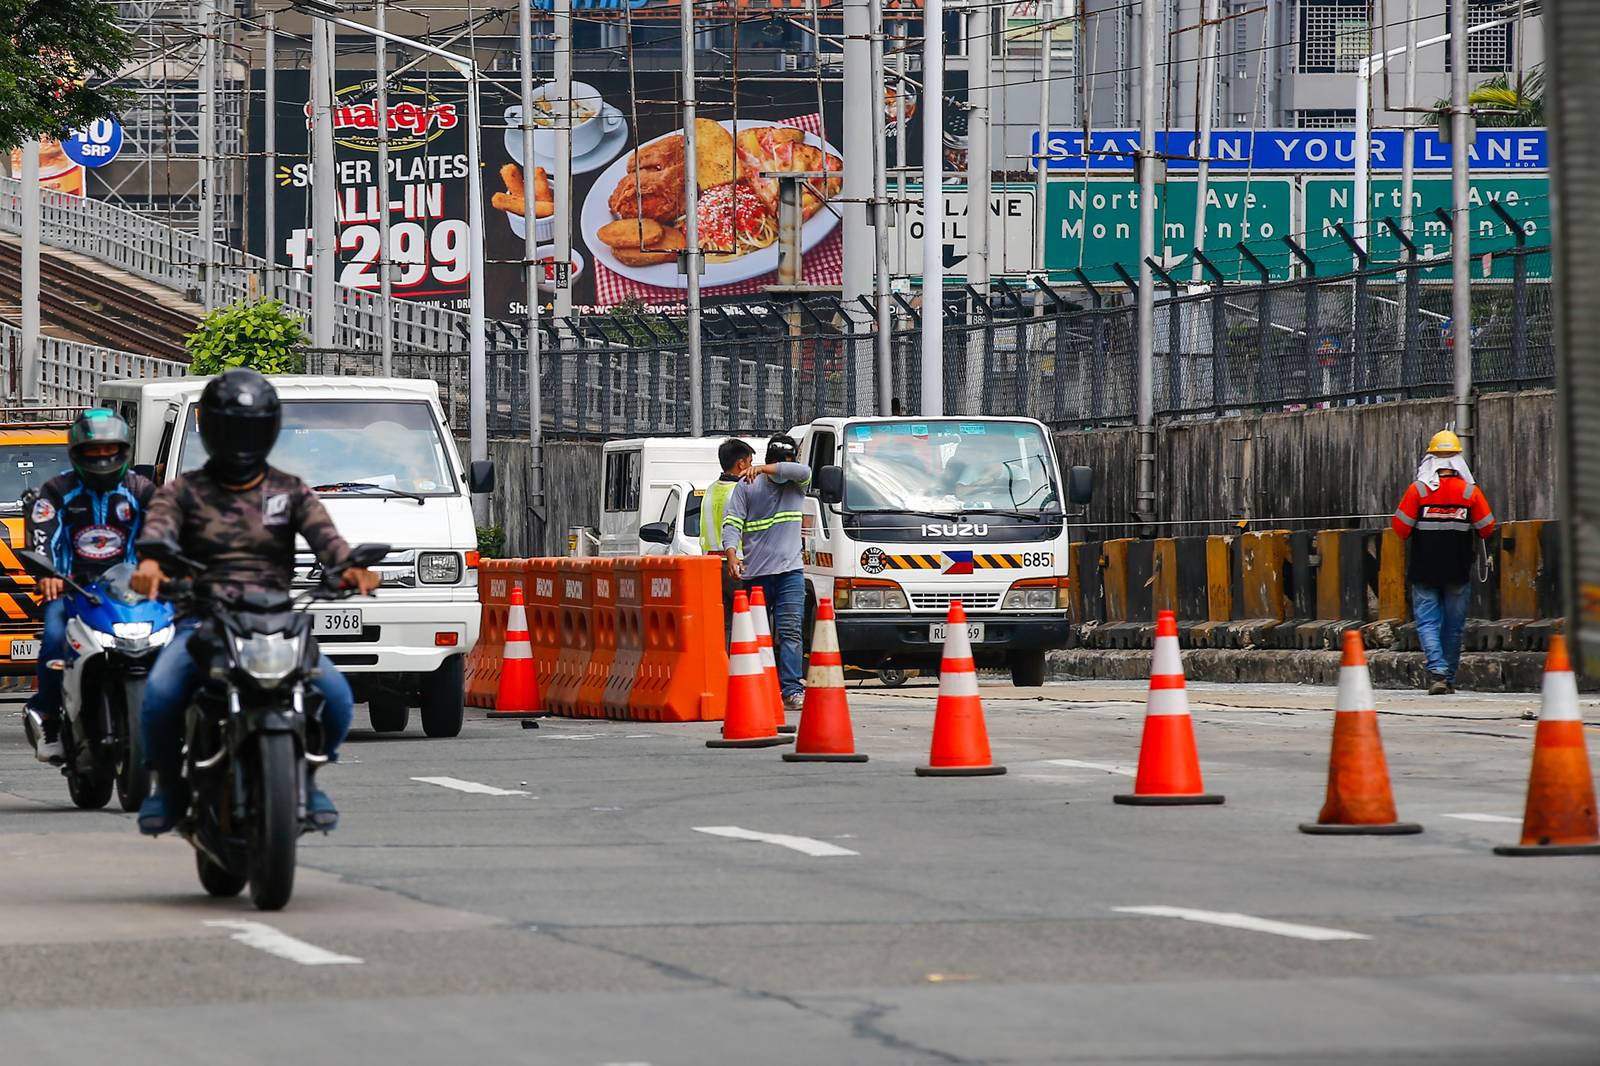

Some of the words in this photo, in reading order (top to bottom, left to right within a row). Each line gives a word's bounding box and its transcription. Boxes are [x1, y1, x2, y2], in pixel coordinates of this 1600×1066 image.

[81, 144, 111, 156] SRP
[1274, 138, 1386, 161] YOUR
[1205, 189, 1268, 209] Ave.
[1330, 188, 1422, 208] Nrth
[1468, 187, 1530, 207] Ave.
[1061, 219, 1274, 239] Monmnto
[508, 302, 546, 315] Shae
[921, 523, 988, 537] ISUZU
[325, 615, 359, 630] 3968
[12, 644, 32, 656] NAV
